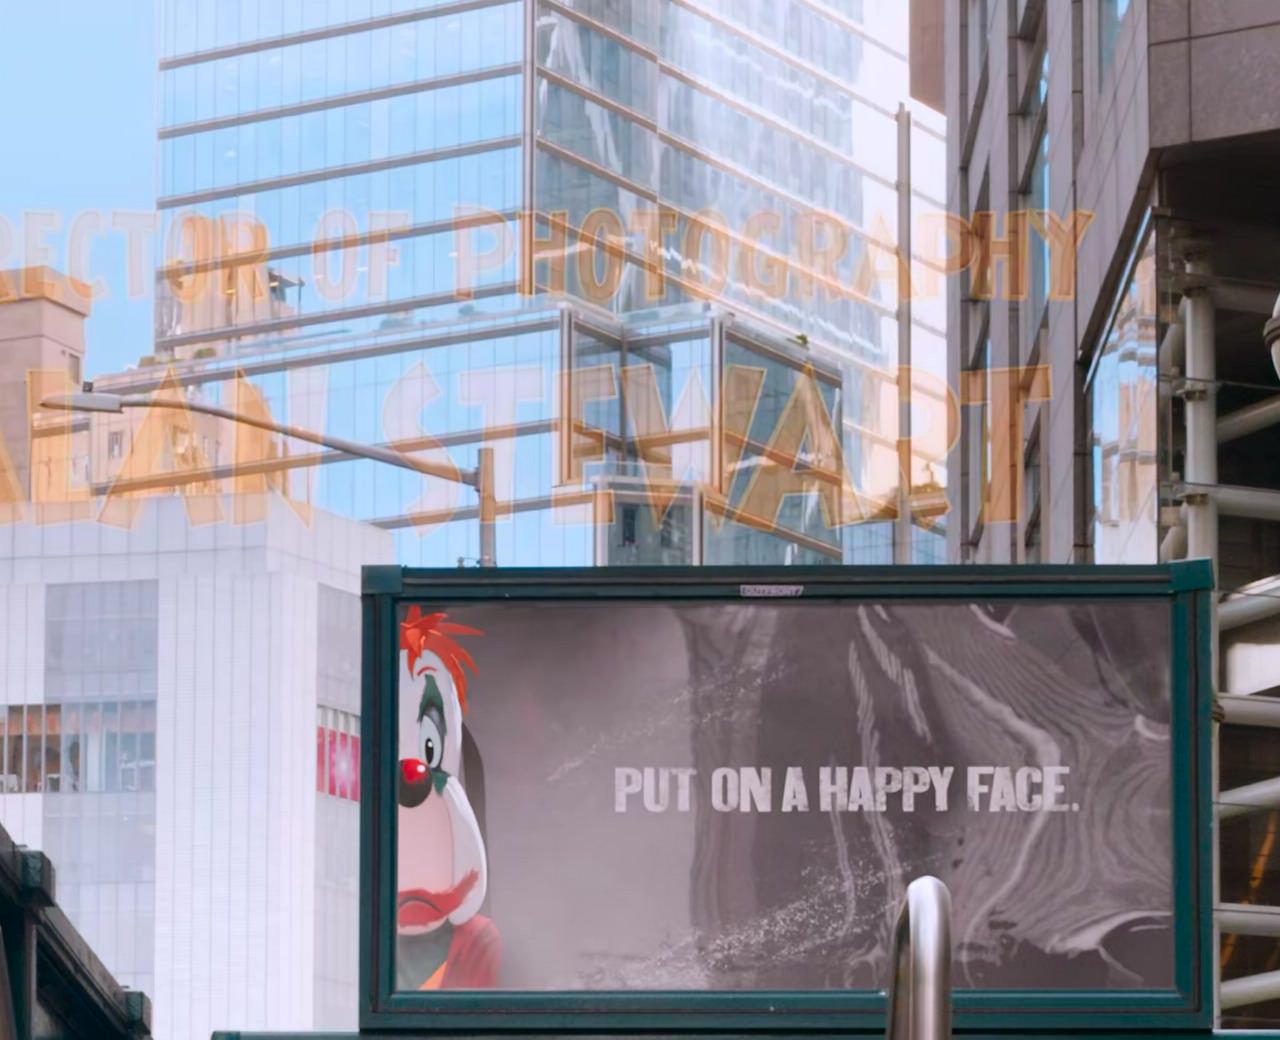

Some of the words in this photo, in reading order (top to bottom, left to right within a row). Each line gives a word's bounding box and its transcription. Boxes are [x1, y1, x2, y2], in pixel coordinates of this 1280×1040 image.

[614, 766, 697, 813] PUT
[711, 766, 772, 813] ON
[782, 766, 809, 812] A
[820, 766, 954, 813] HAPPY
[967, 766, 1080, 813] FACE.
